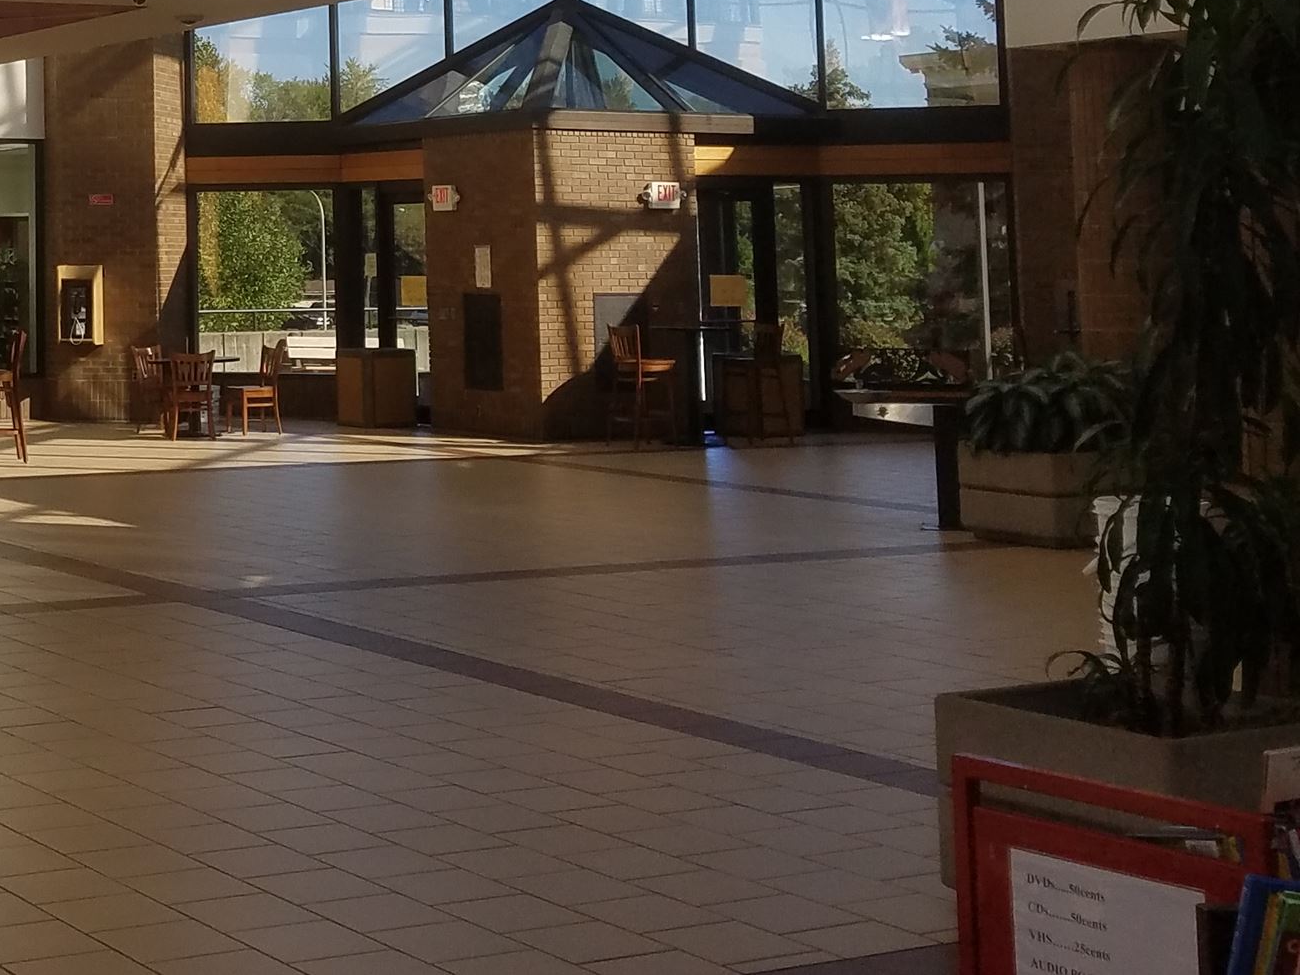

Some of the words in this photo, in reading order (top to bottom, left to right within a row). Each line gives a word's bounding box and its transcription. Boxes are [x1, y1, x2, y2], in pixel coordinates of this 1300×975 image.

[435, 188, 449, 203] EXIT
[658, 185, 676, 201] EXIT
[1030, 957, 1068, 975] AUDIO
